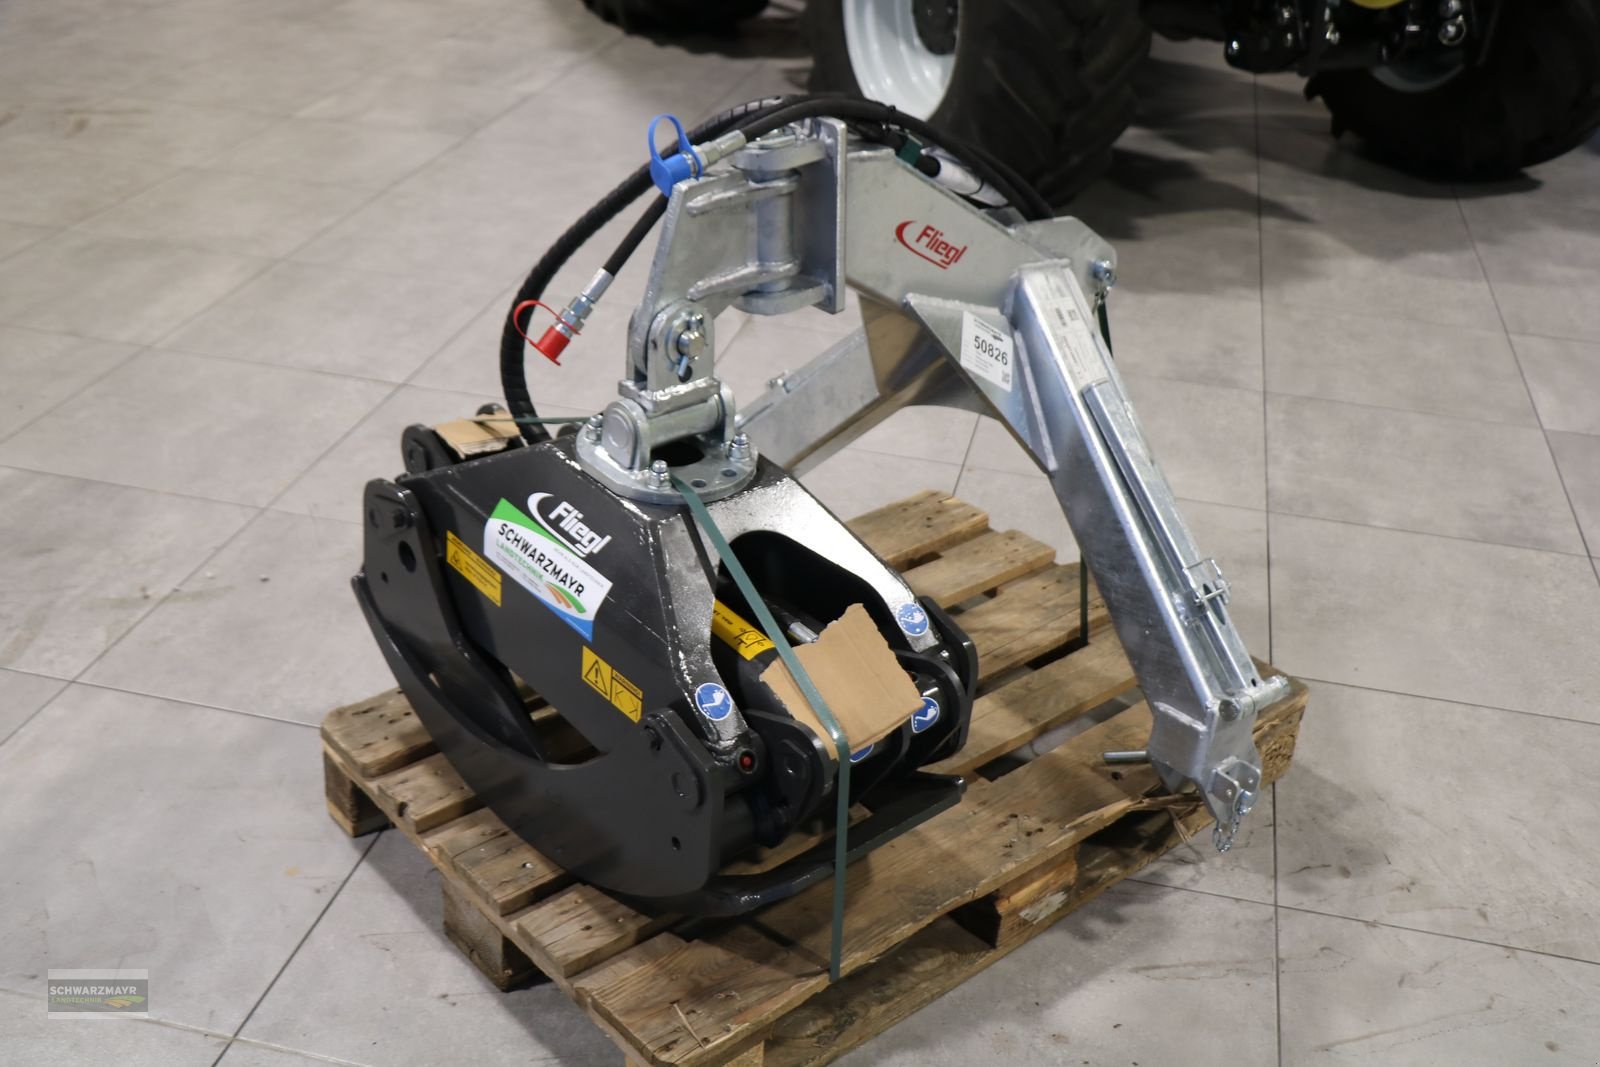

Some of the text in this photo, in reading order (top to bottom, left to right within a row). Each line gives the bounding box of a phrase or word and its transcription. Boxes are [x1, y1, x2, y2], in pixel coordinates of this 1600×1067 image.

[915, 224, 968, 266] Fliegl
[974, 335, 1008, 366] 50826
[548, 500, 613, 555] Fliegl
[497, 523, 586, 598] SCHWARZMAYR
